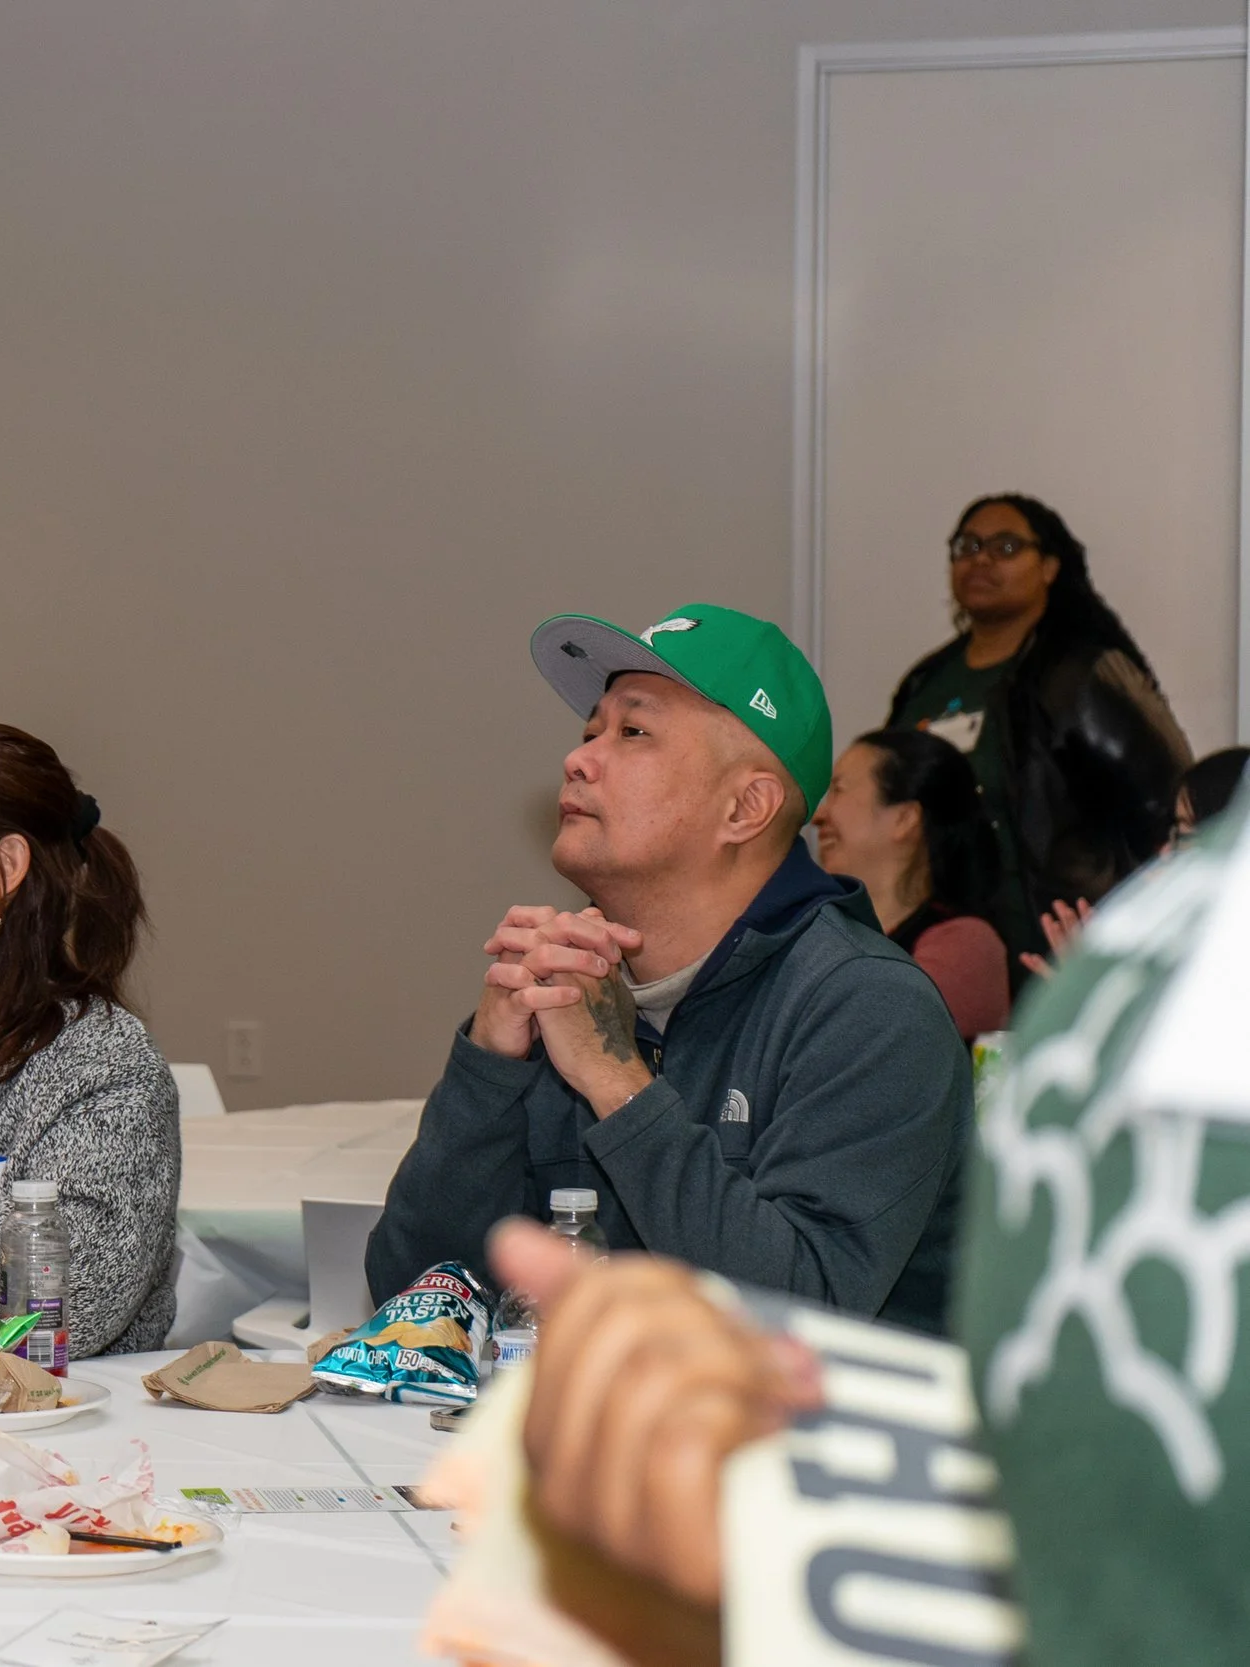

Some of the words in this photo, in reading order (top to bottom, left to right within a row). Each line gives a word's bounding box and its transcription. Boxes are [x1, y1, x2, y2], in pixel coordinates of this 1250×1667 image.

[385, 1305, 461, 1323] TASTY
[332, 1348, 365, 1363] POTATO
[367, 1350, 390, 1365] CHIPS
[399, 1350, 419, 1367] 150
